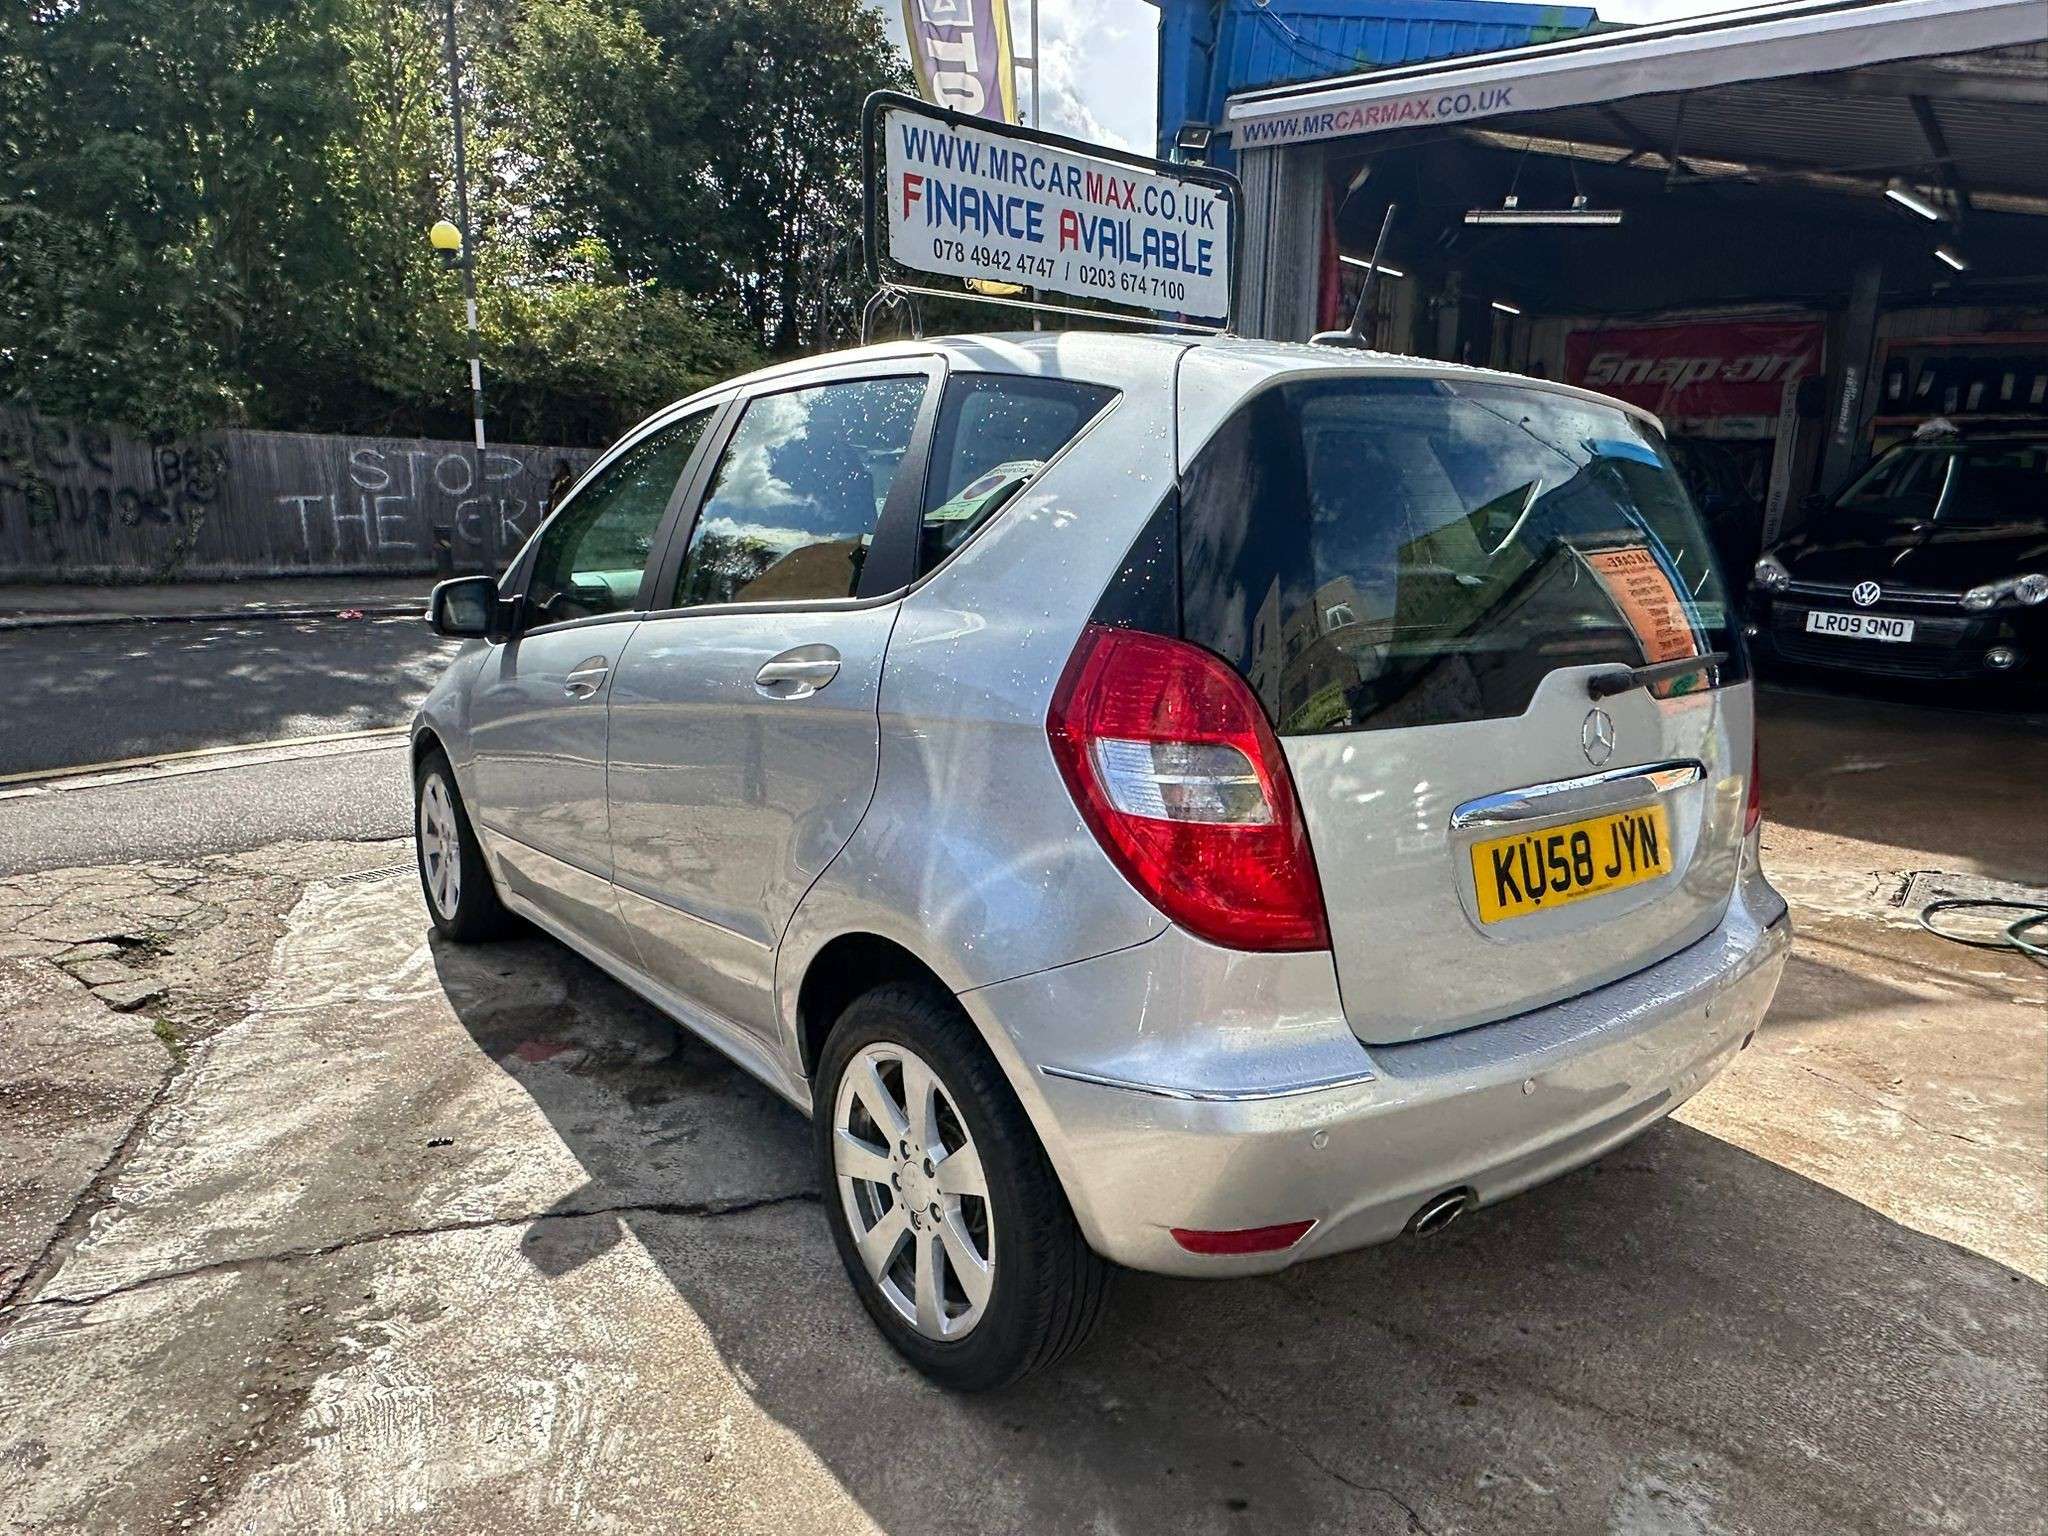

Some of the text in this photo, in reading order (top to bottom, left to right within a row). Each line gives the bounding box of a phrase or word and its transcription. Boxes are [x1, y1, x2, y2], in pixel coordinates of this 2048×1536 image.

[1242, 87, 1513, 143] WWW.MRCARMAX.CO.UK
[902, 124, 1214, 230] WWW.MRCARMAX.CO.UK
[903, 172, 1214, 277] FINANCE AVAILABLE
[933, 238, 965, 263] 078
[970, 245, 1012, 271] 4942
[1016, 253, 1055, 278] 4747
[1079, 264, 1116, 287] 0203
[1120, 272, 1148, 294] 674
[1150, 278, 1185, 301] 7100
[350, 447, 524, 498] STOP
[280, 495, 417, 556] THE
[1814, 613, 1861, 633] LR09
[1492, 814, 1661, 907] KU58 JYN
